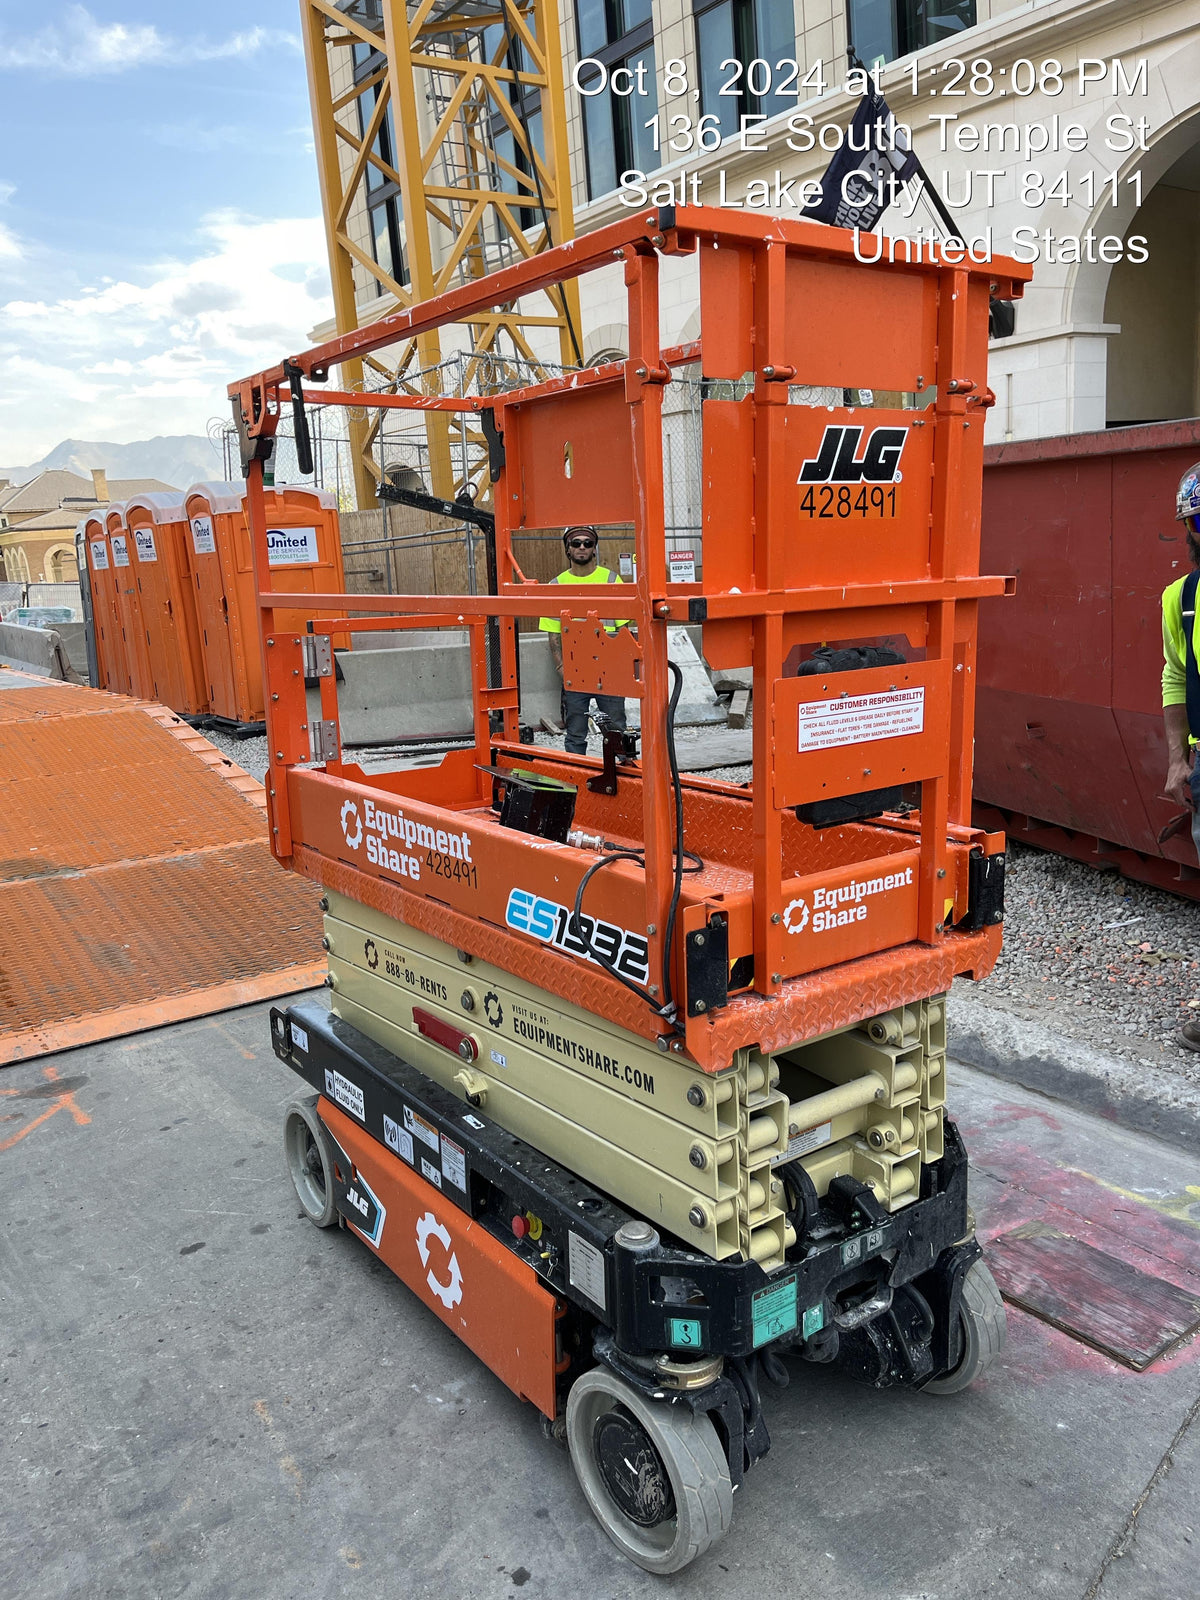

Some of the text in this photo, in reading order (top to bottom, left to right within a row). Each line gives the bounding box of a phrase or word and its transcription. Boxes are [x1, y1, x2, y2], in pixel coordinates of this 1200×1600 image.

[842, 185, 874, 229] WOK
[797, 425, 909, 484] JLG
[800, 486, 896, 518] 428491
[266, 536, 308, 548] United
[670, 552, 693, 560] DANGER
[829, 691, 924, 711] CUSTOMER RESPONSIBILITY
[810, 729, 835, 738] INSURANCE
[892, 716, 913, 724] REFUELING
[826, 735, 851, 744] EQUIPMENT
[871, 727, 899, 736] MAINTENANCE
[901, 723, 921, 731] CLEANING
[363, 799, 473, 863] Equipment
[366, 834, 420, 881] Share
[426, 850, 478, 889] 428491
[813, 867, 913, 909] Equipment
[812, 905, 868, 933] Share
[506, 888, 649, 985] ES1932
[384, 949, 406, 964] CALL NOW
[385, 960, 448, 1001] 888-80-RENTS
[512, 1004, 549, 1025] VISIT US AT:
[513, 1017, 655, 1095] EQUIPMENTSHARE.COM
[335, 1074, 363, 1103] HYDRAULIC
[335, 1088, 364, 1116] FLUID ONLY
[346, 1187, 369, 1217] JLG
[766, 1279, 790, 1293] DANGER
